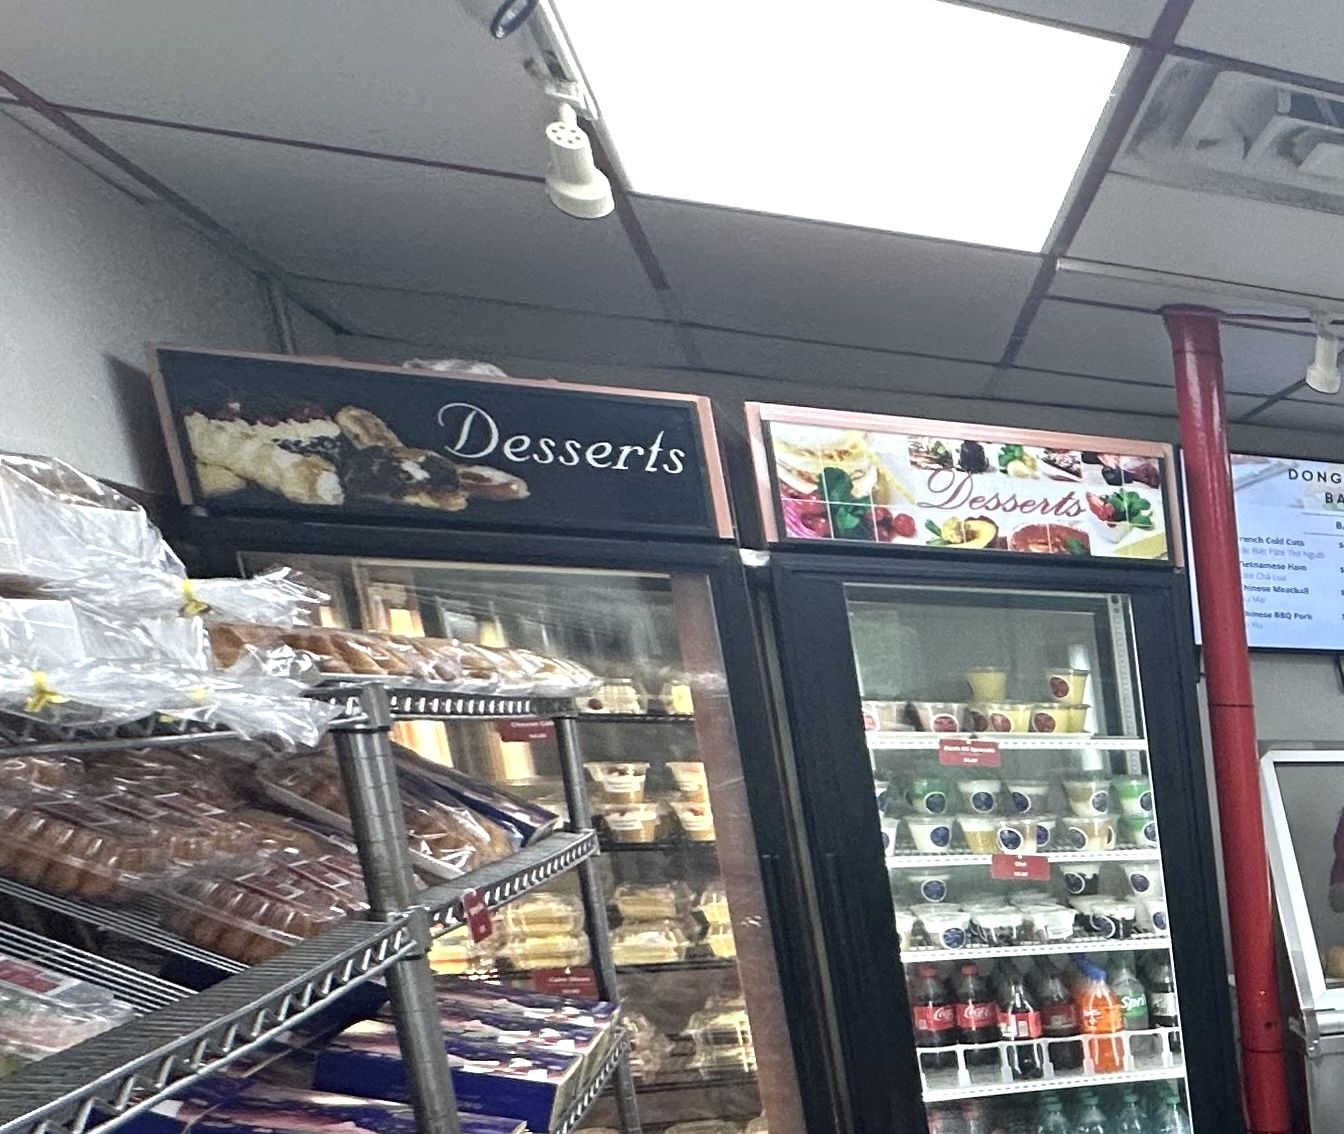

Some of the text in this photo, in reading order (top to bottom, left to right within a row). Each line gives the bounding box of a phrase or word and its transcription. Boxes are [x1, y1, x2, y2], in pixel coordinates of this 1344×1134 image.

[437, 402, 686, 475] Desserts
[916, 468, 1087, 517] Desserts
[1288, 468, 1342, 485] DONG
